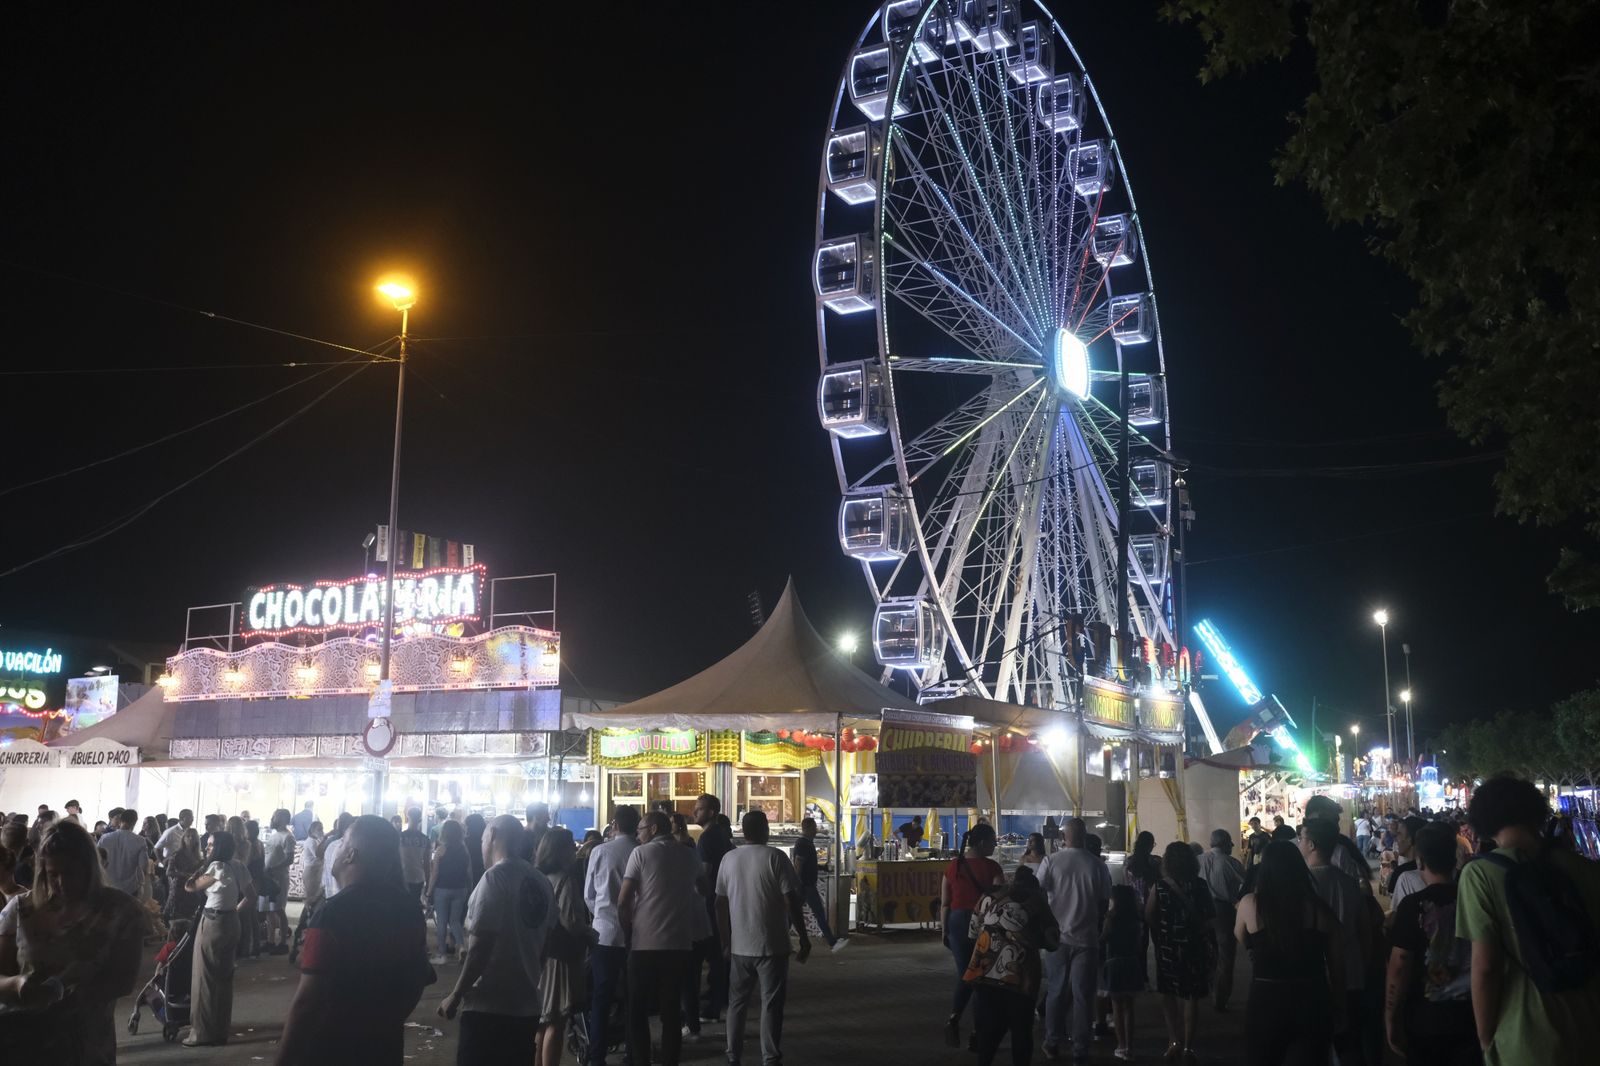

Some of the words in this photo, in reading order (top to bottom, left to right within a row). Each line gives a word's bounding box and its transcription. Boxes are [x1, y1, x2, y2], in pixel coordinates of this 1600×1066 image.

[5, 648, 62, 674] VACILÓN
[609, 735, 690, 752] TAQUILLA
[0, 751, 49, 765] CHURRERIA
[70, 751, 105, 765] ABUELO
[107, 750, 130, 764] PACO
